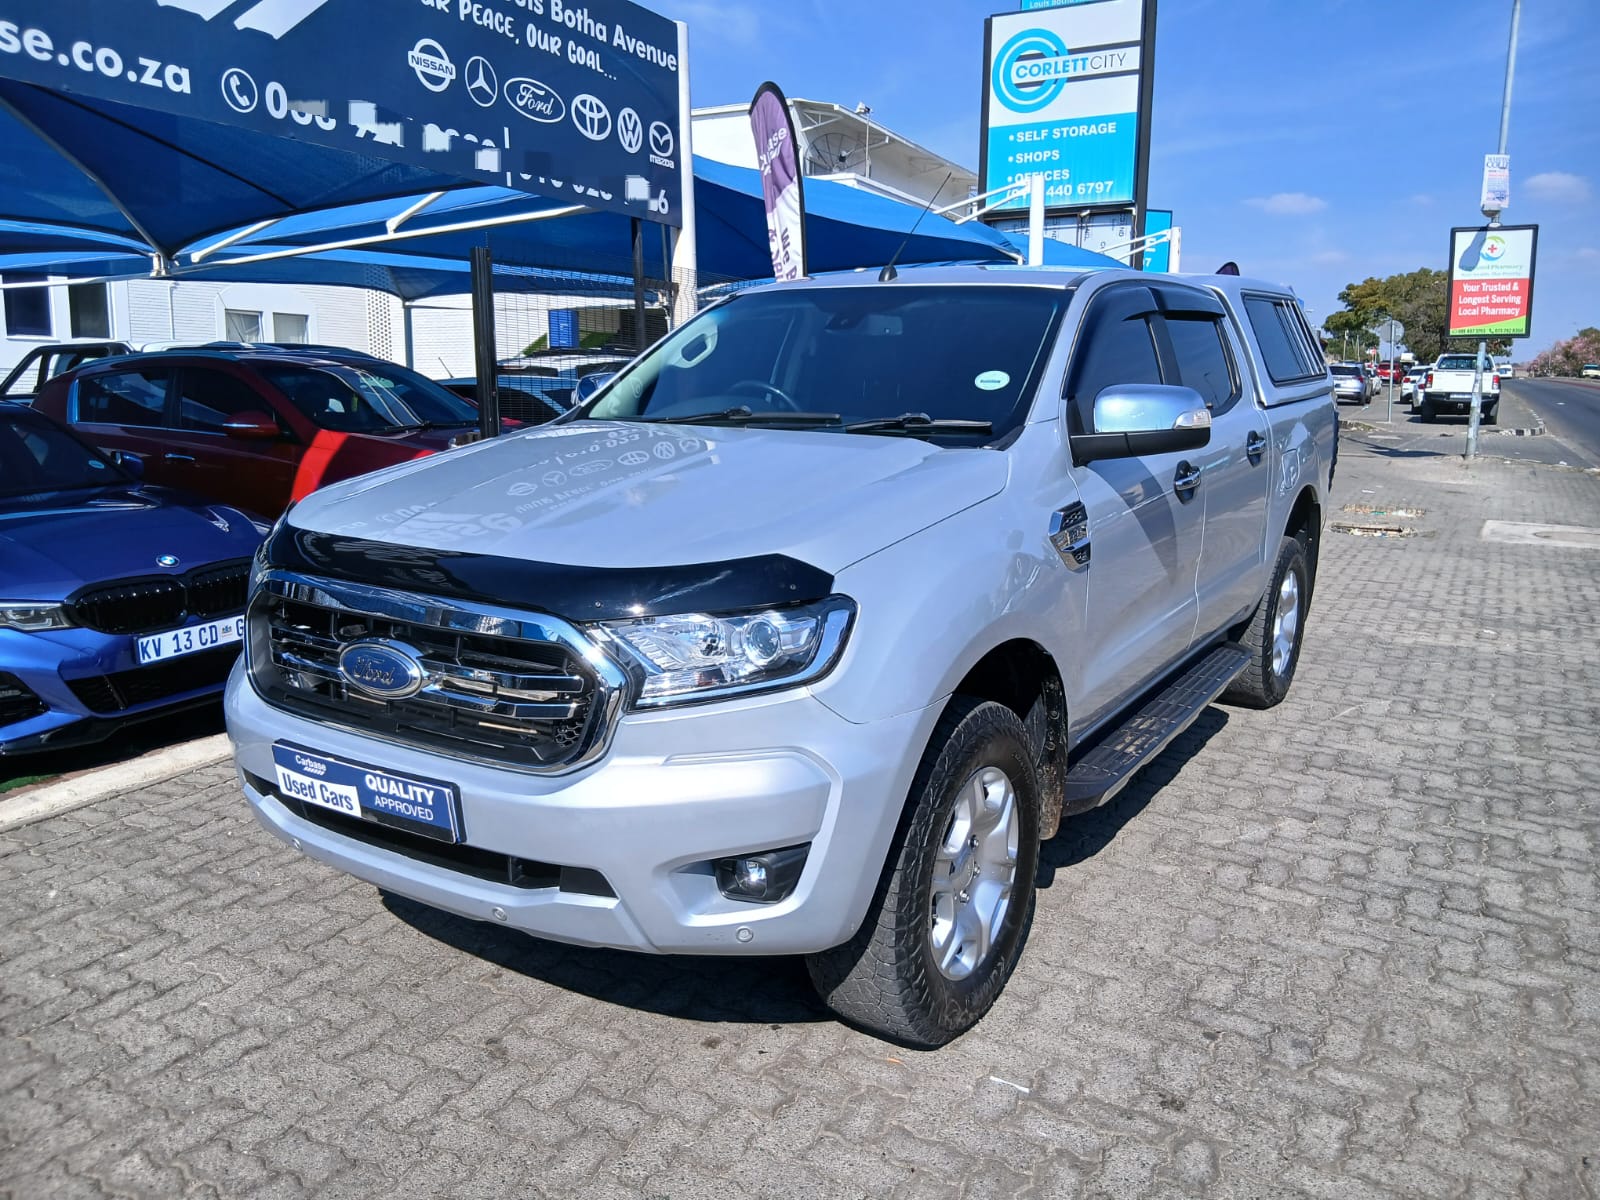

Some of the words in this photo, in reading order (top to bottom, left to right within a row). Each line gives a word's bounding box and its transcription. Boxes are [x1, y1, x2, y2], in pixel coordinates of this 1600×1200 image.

[527, 24, 561, 57] OUR
[551, 5, 607, 42] Botha
[612, 24, 677, 72] Avenue
[411, 54, 454, 77] NISSAN
[516, 82, 554, 116] Ford
[1016, 129, 1049, 143] SELF
[1052, 122, 1117, 140] STORAGE
[1015, 150, 1060, 164] SHOPS
[1046, 184, 1073, 197] 440
[1077, 181, 1114, 195] 6797
[1463, 283, 1480, 293] Your
[1481, 282, 1511, 292] Trusted
[1512, 282, 1519, 291] &
[1458, 295, 1489, 305] Longest
[1491, 294, 1522, 305] Serving
[1458, 307, 1479, 316] Local
[1480, 306, 1521, 317] Pharmacy
[140, 637, 161, 661] KV
[172, 630, 193, 654] 13
[198, 624, 219, 646] CD
[295, 754, 327, 772] Carbase
[282, 772, 317, 800] Used
[319, 783, 354, 811] Cars
[364, 774, 435, 806] QUALITY
[374, 795, 434, 822] APPROVED
